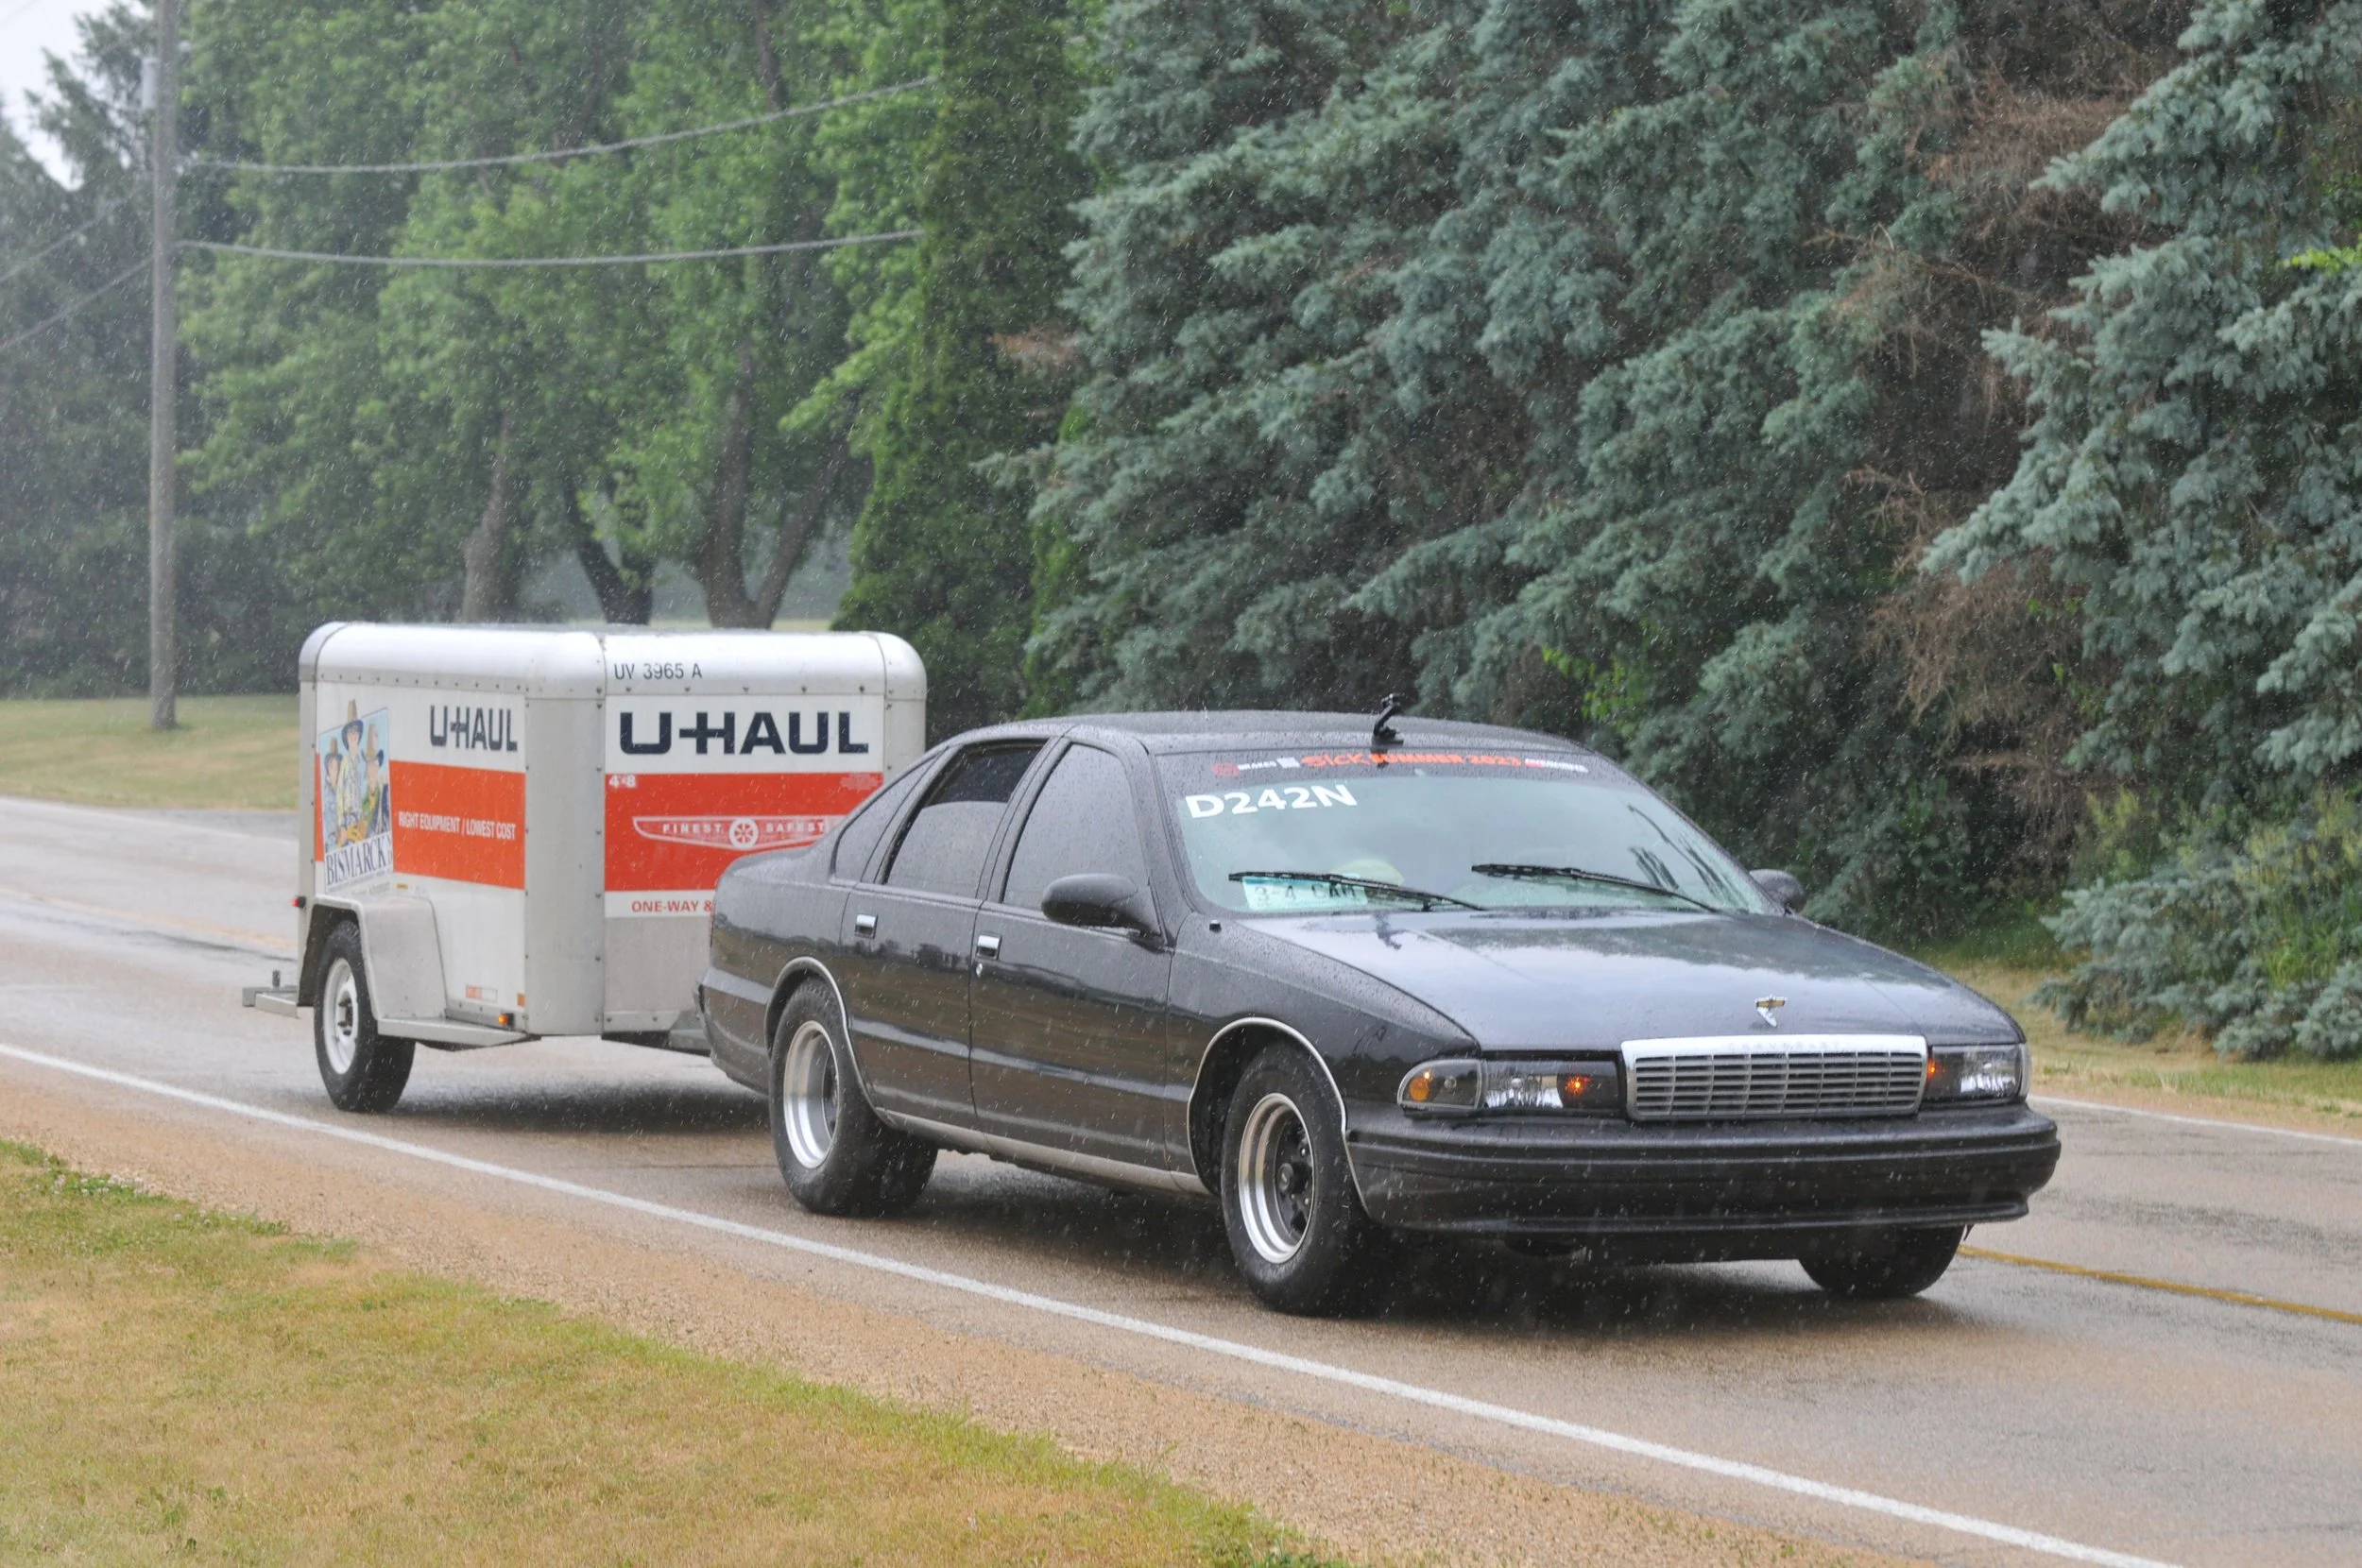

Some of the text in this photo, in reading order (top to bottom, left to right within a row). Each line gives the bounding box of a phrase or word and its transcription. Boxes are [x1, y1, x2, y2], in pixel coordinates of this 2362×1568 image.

[614, 663, 703, 680] UV 3965 A
[430, 705, 518, 752] U-HAUL
[620, 712, 868, 754] U-HAUL
[1186, 785, 1358, 819] D242N
[398, 810, 419, 828] RIGHT
[419, 813, 460, 834] EQUIPMENT
[467, 818, 496, 838] LOWEST
[496, 821, 517, 841] COST
[662, 823, 722, 834] FINEST
[631, 899, 699, 913] ONE-WAY
